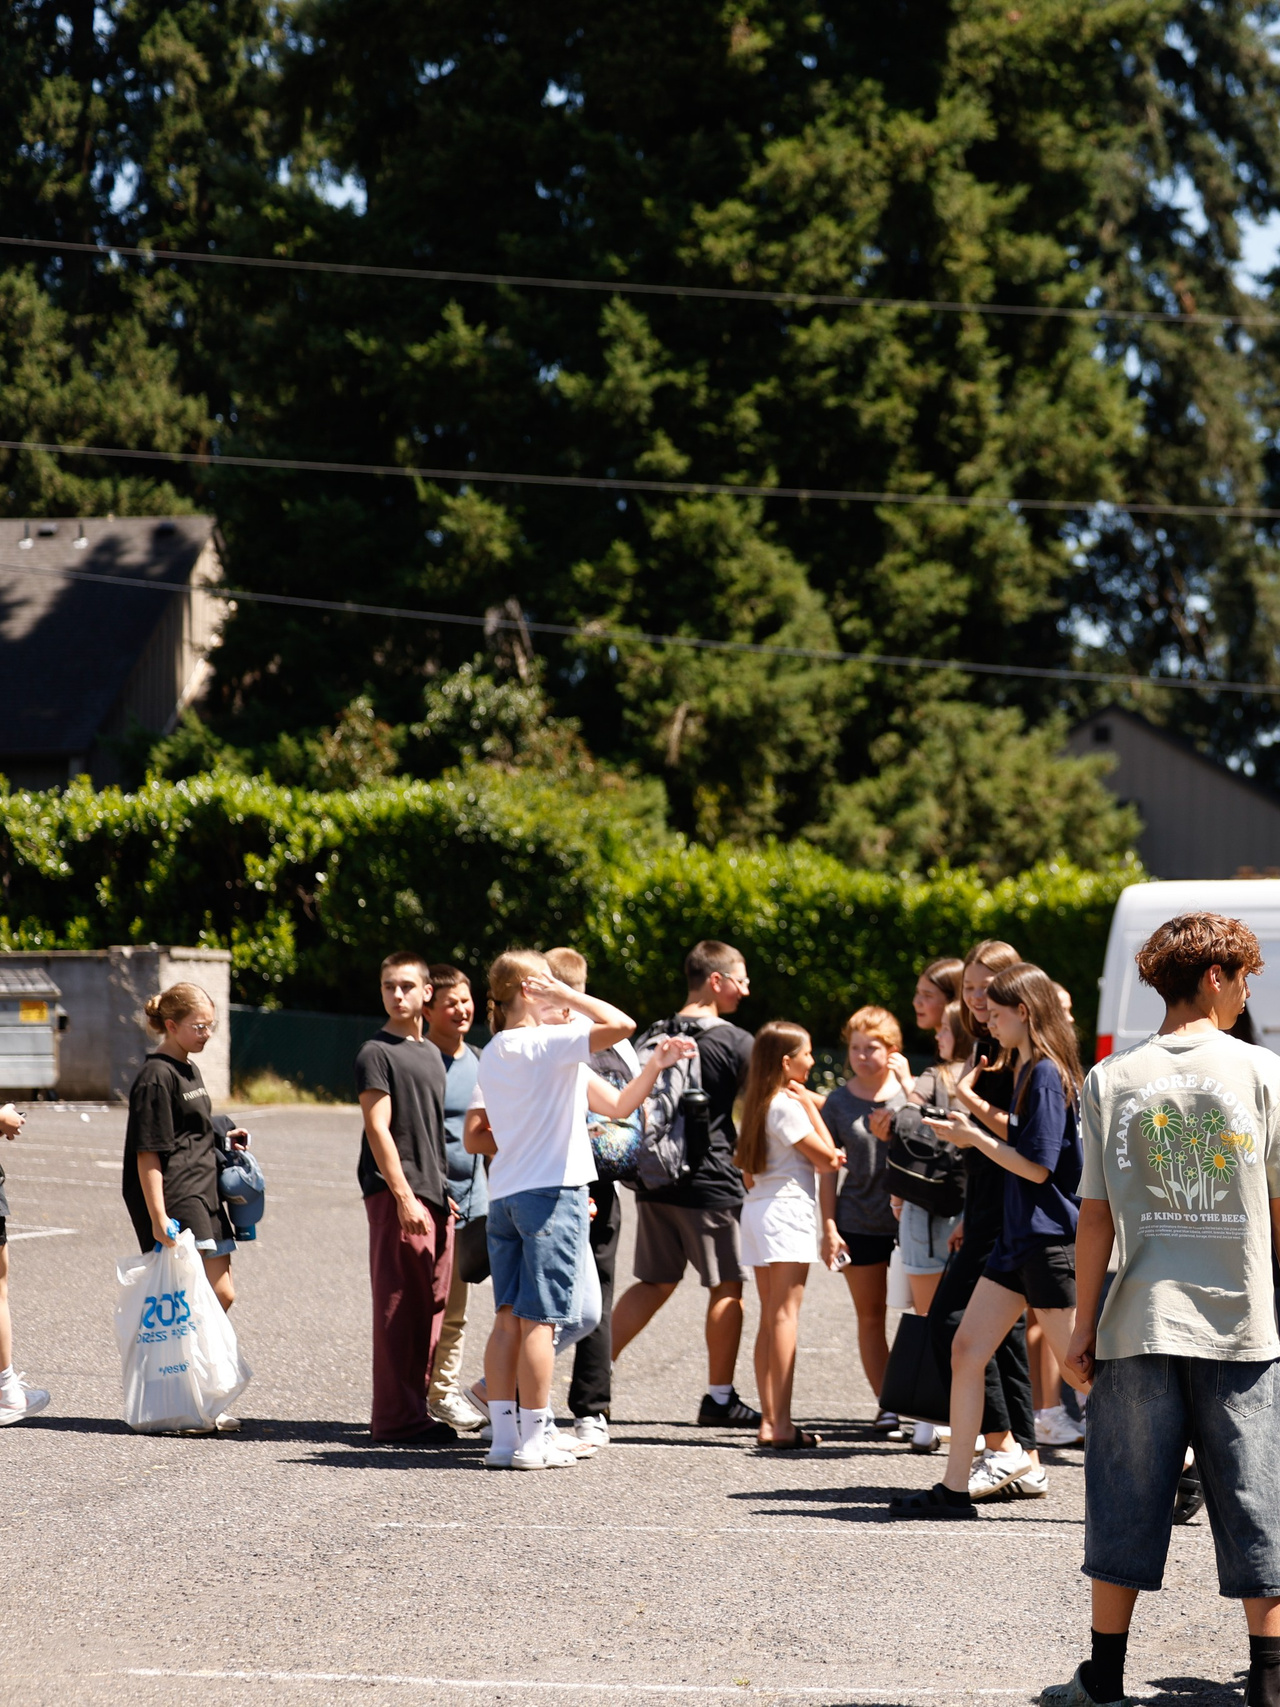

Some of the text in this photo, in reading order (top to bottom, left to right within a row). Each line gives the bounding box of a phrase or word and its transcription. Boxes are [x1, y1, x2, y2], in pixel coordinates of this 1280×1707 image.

[1116, 1074, 1258, 1170] PLANT MORE FLOWS
[1141, 1212, 1246, 1223] BE KIND TO THE BEES
